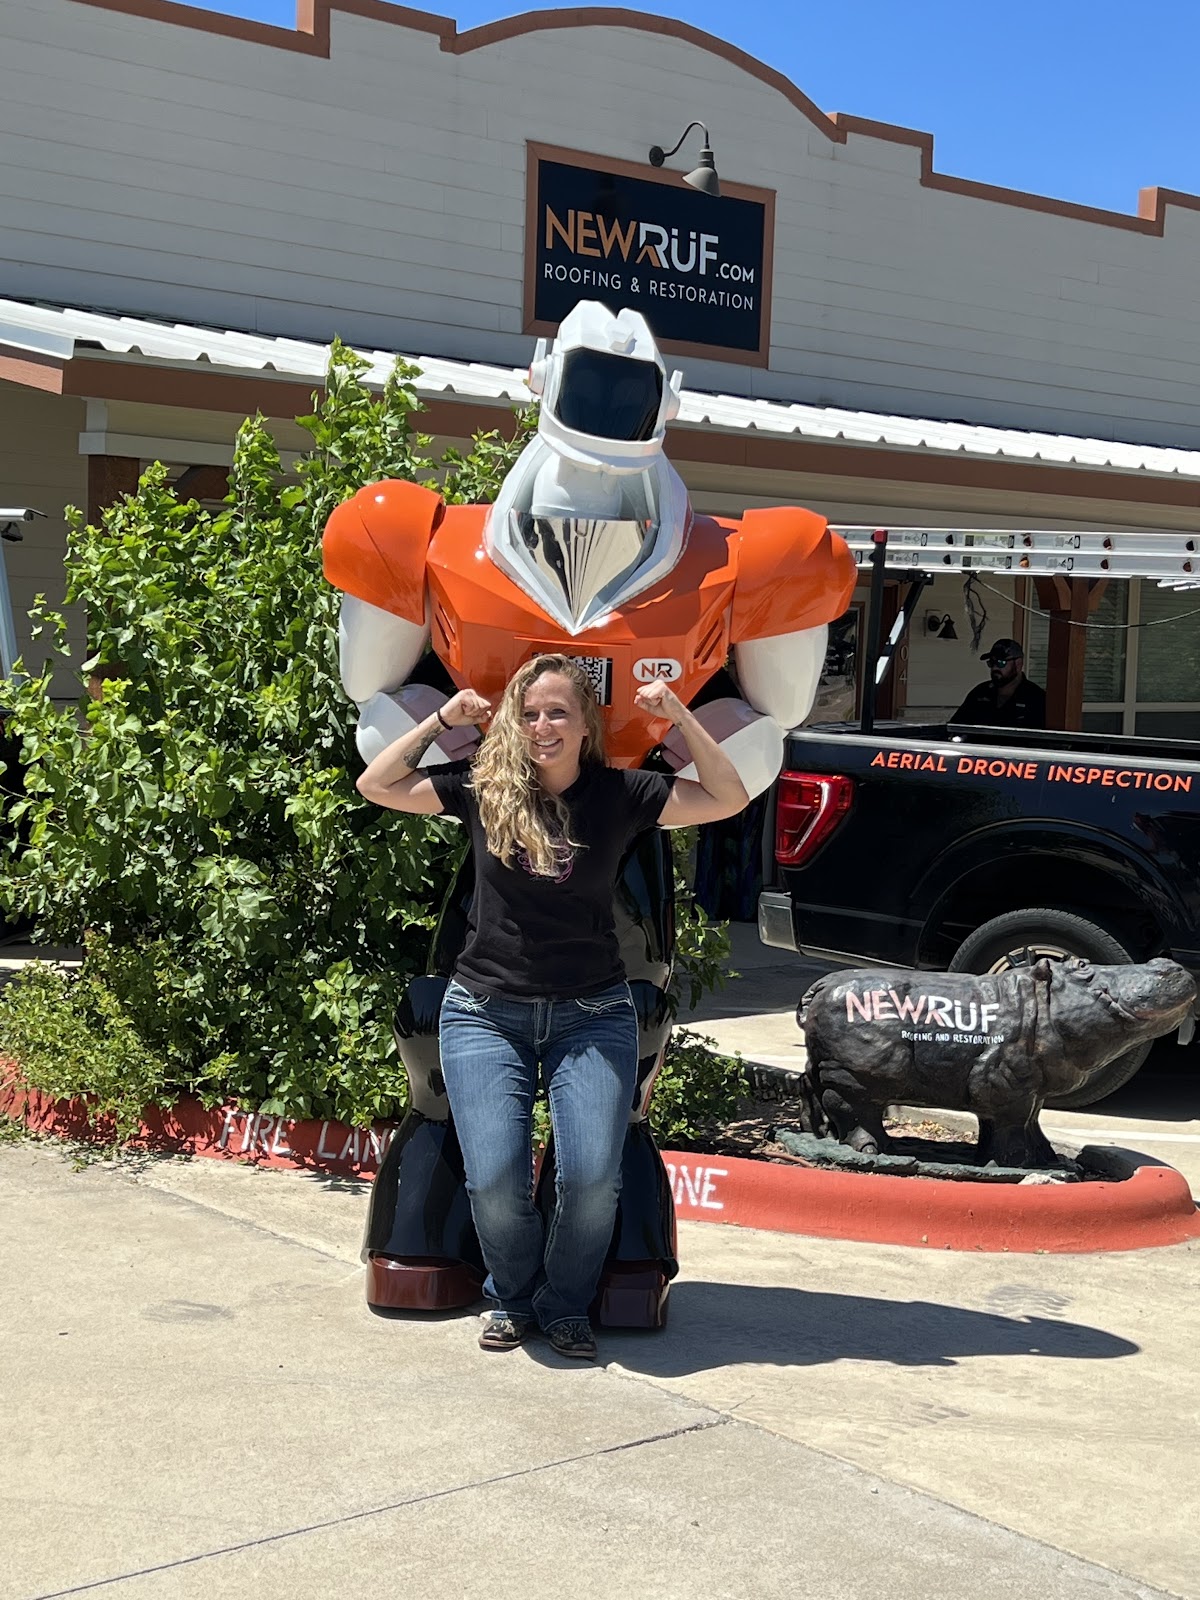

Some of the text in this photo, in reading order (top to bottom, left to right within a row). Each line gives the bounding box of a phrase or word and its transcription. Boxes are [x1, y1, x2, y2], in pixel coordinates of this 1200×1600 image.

[544, 263, 753, 311] ROOFING & RESTORATION
[641, 663, 672, 678] NR
[870, 751, 1192, 793] AERIAL DRONE INSPECTION
[935, 1033, 949, 1042] AND
[953, 1033, 1004, 1045] RESTORATION
[218, 1109, 397, 1165] FIRE LAN
